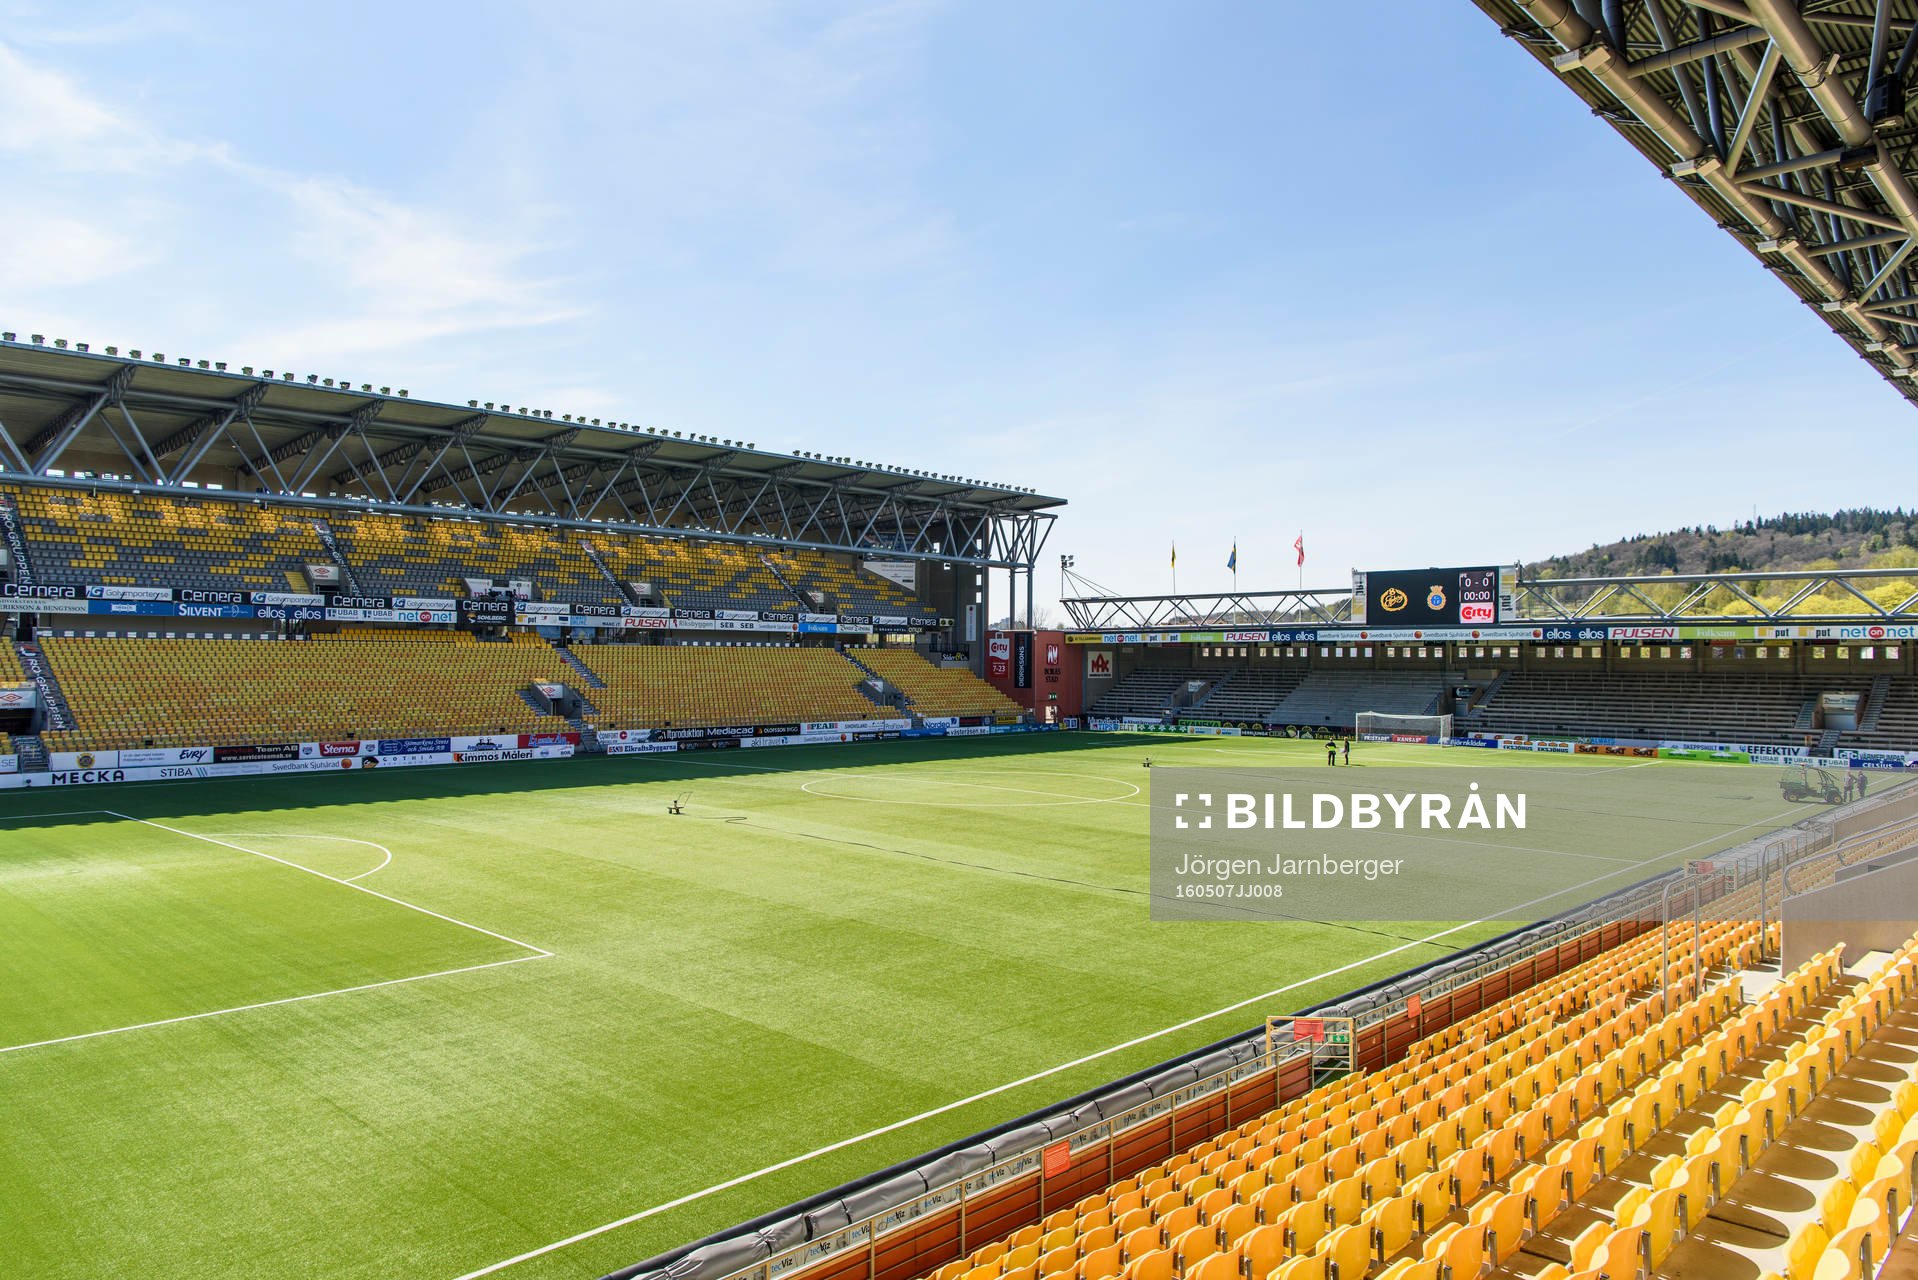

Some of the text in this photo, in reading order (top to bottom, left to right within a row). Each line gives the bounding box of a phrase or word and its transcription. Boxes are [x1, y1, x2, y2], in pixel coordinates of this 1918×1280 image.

[1465, 578, 1471, 587] 0
[1482, 577, 1489, 587] 0
[4, 584, 75, 598] Cernera
[181, 589, 242, 603] Cernera
[1463, 590, 1490, 600] 00:00
[332, 595, 385, 608] Cernera
[463, 600, 508, 611] Cernera
[178, 603, 223, 617] SILVENT
[257, 606, 286, 618] ellos
[294, 607, 321, 619] ellos
[373, 609, 393, 617] UBAB
[576, 604, 616, 615] Cernera
[674, 608, 711, 619] Cernera
[762, 612, 794, 621] Cernera
[624, 618, 668, 628] PULSEN
[1225, 632, 1267, 641] PULSEN
[1271, 631, 1291, 641] ellos
[1295, 631, 1315, 641] ellos
[1546, 628, 1572, 639] ellos
[1578, 628, 1604, 639] ellos
[1612, 628, 1674, 638] PULSEN
[810, 722, 835, 730] PEAB
[456, 749, 533, 762] Kimmos Måleri
[1747, 745, 1801, 756] EFFEKTIV
[272, 760, 308, 771] Swedbank
[310, 760, 340, 770] Sjuhärad
[52, 770, 125, 785] MECKA
[160, 767, 193, 778] STIBA
[886, 1210, 905, 1224] tecViz
[809, 1241, 831, 1256] tecViz
[771, 1257, 794, 1273] tecViz
